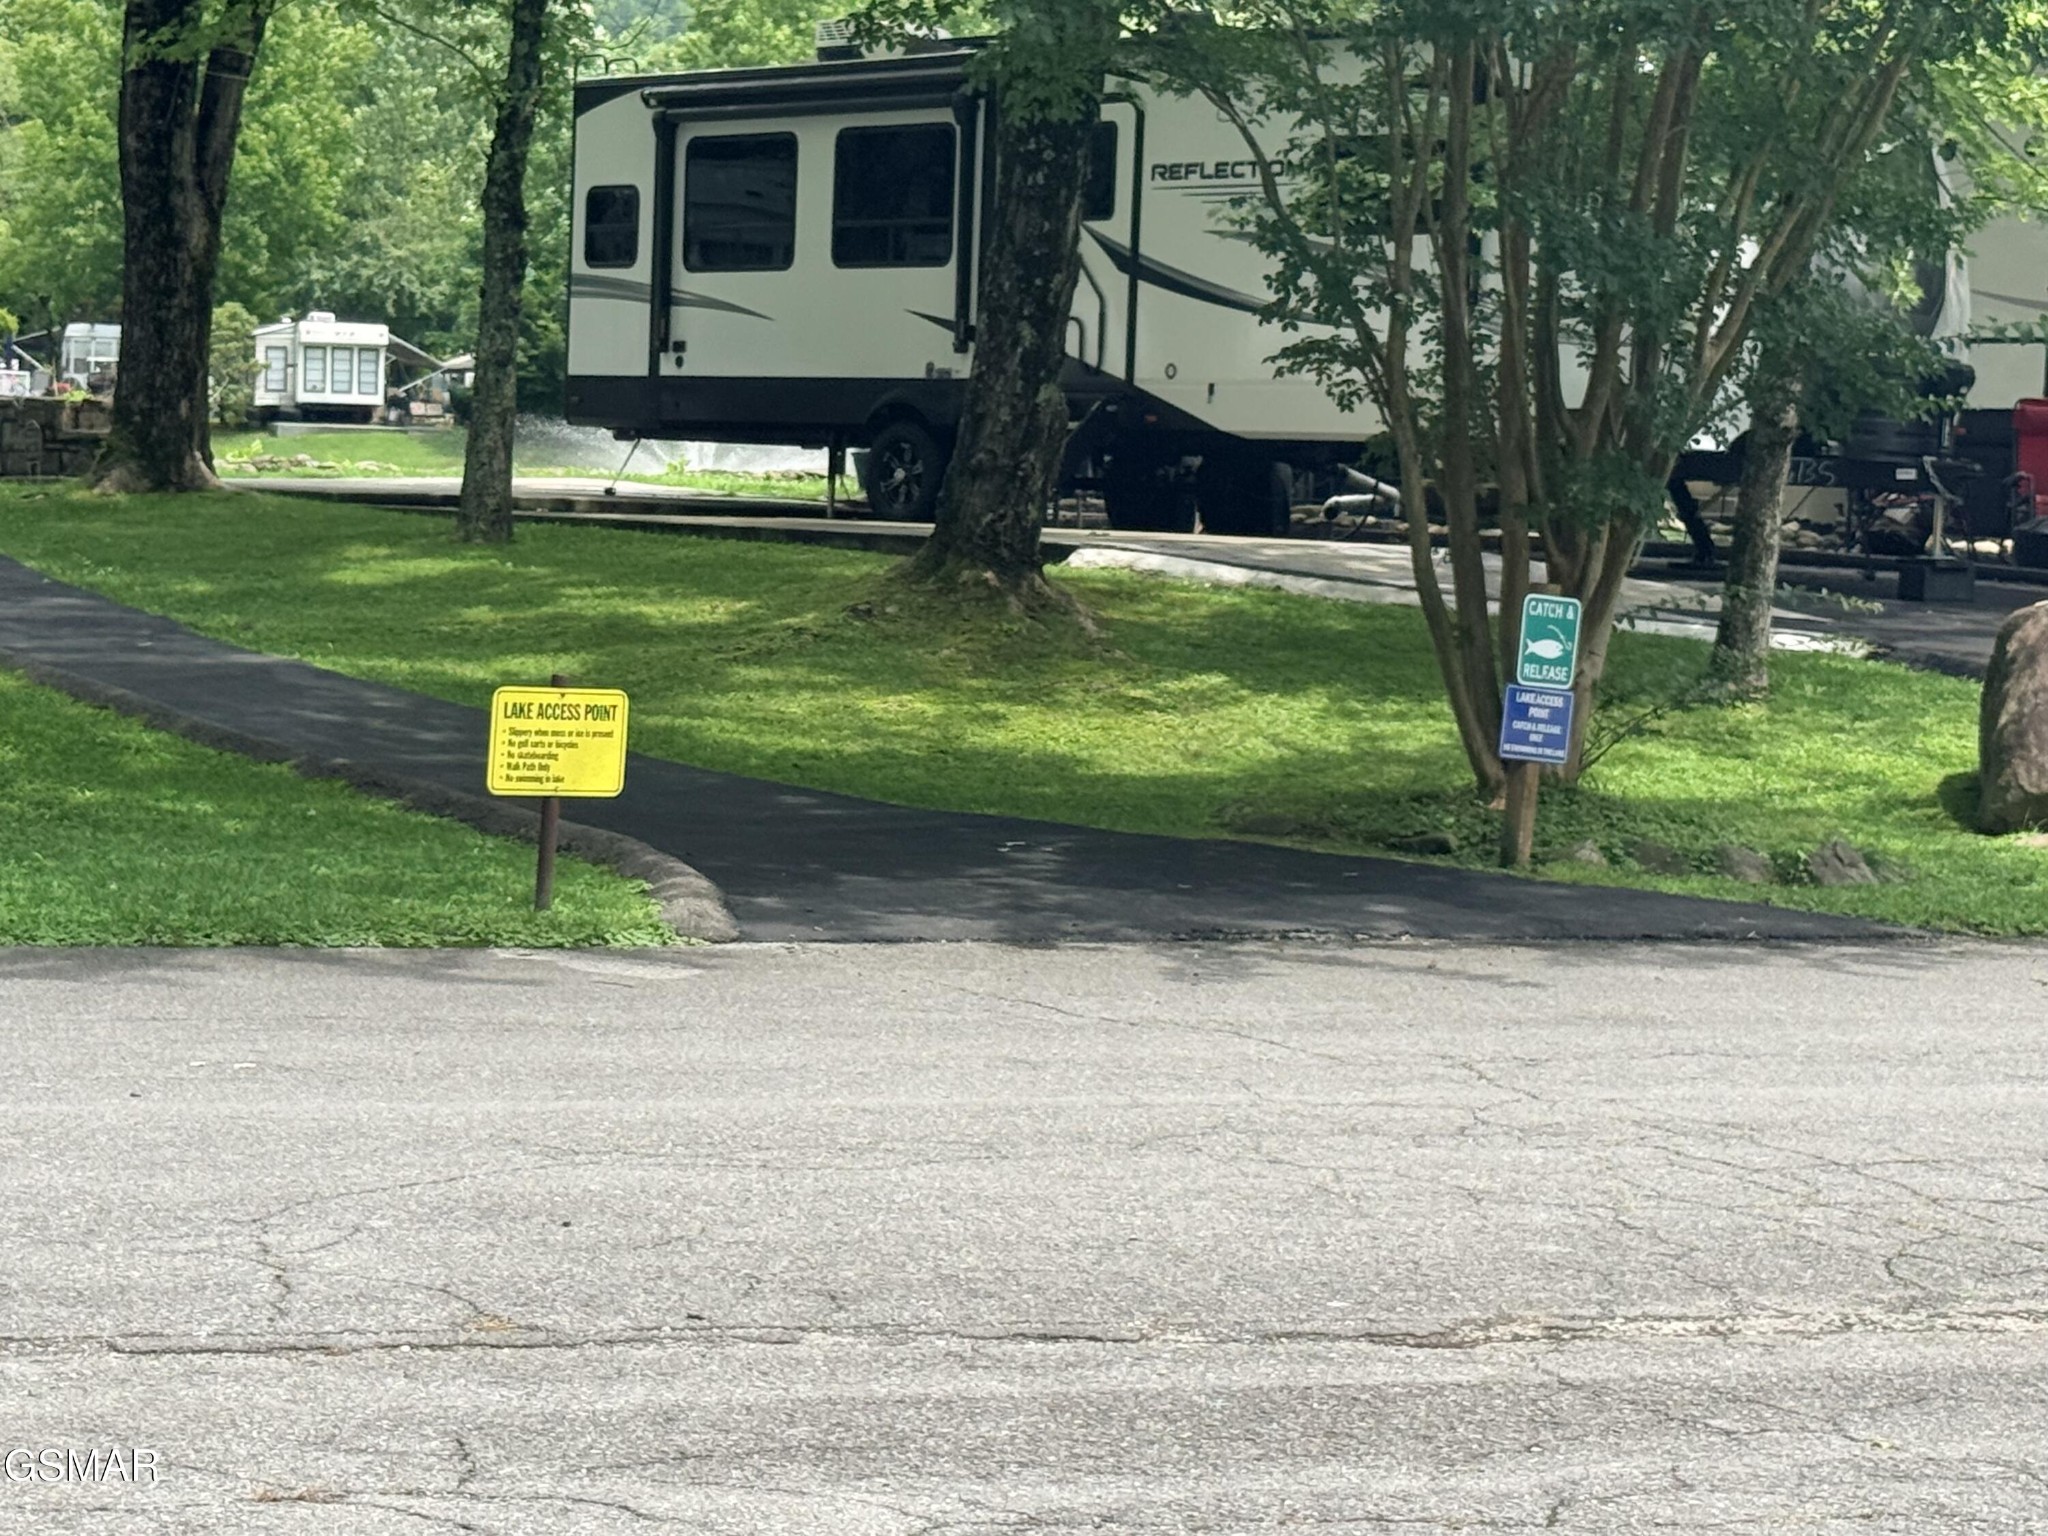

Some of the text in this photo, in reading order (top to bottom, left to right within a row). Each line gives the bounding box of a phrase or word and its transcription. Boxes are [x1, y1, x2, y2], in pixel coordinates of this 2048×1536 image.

[1151, 160, 1302, 181] REFLECTO
[1529, 601, 1563, 618] CATCH
[1523, 663, 1568, 681] RELEASE
[1516, 691, 1564, 708] LAKE ACCESS
[504, 702, 618, 721] LAKE ACCESS POINT
[508, 727, 533, 738] Slippery
[534, 729, 549, 737] when
[592, 730, 614, 739] present
[508, 739, 516, 747] No
[517, 739, 529, 749] golf
[555, 741, 579, 750] bicycles
[507, 751, 515, 759] No
[522, 762, 536, 771] Path
[505, 773, 514, 782] No
[552, 774, 565, 783] lake
